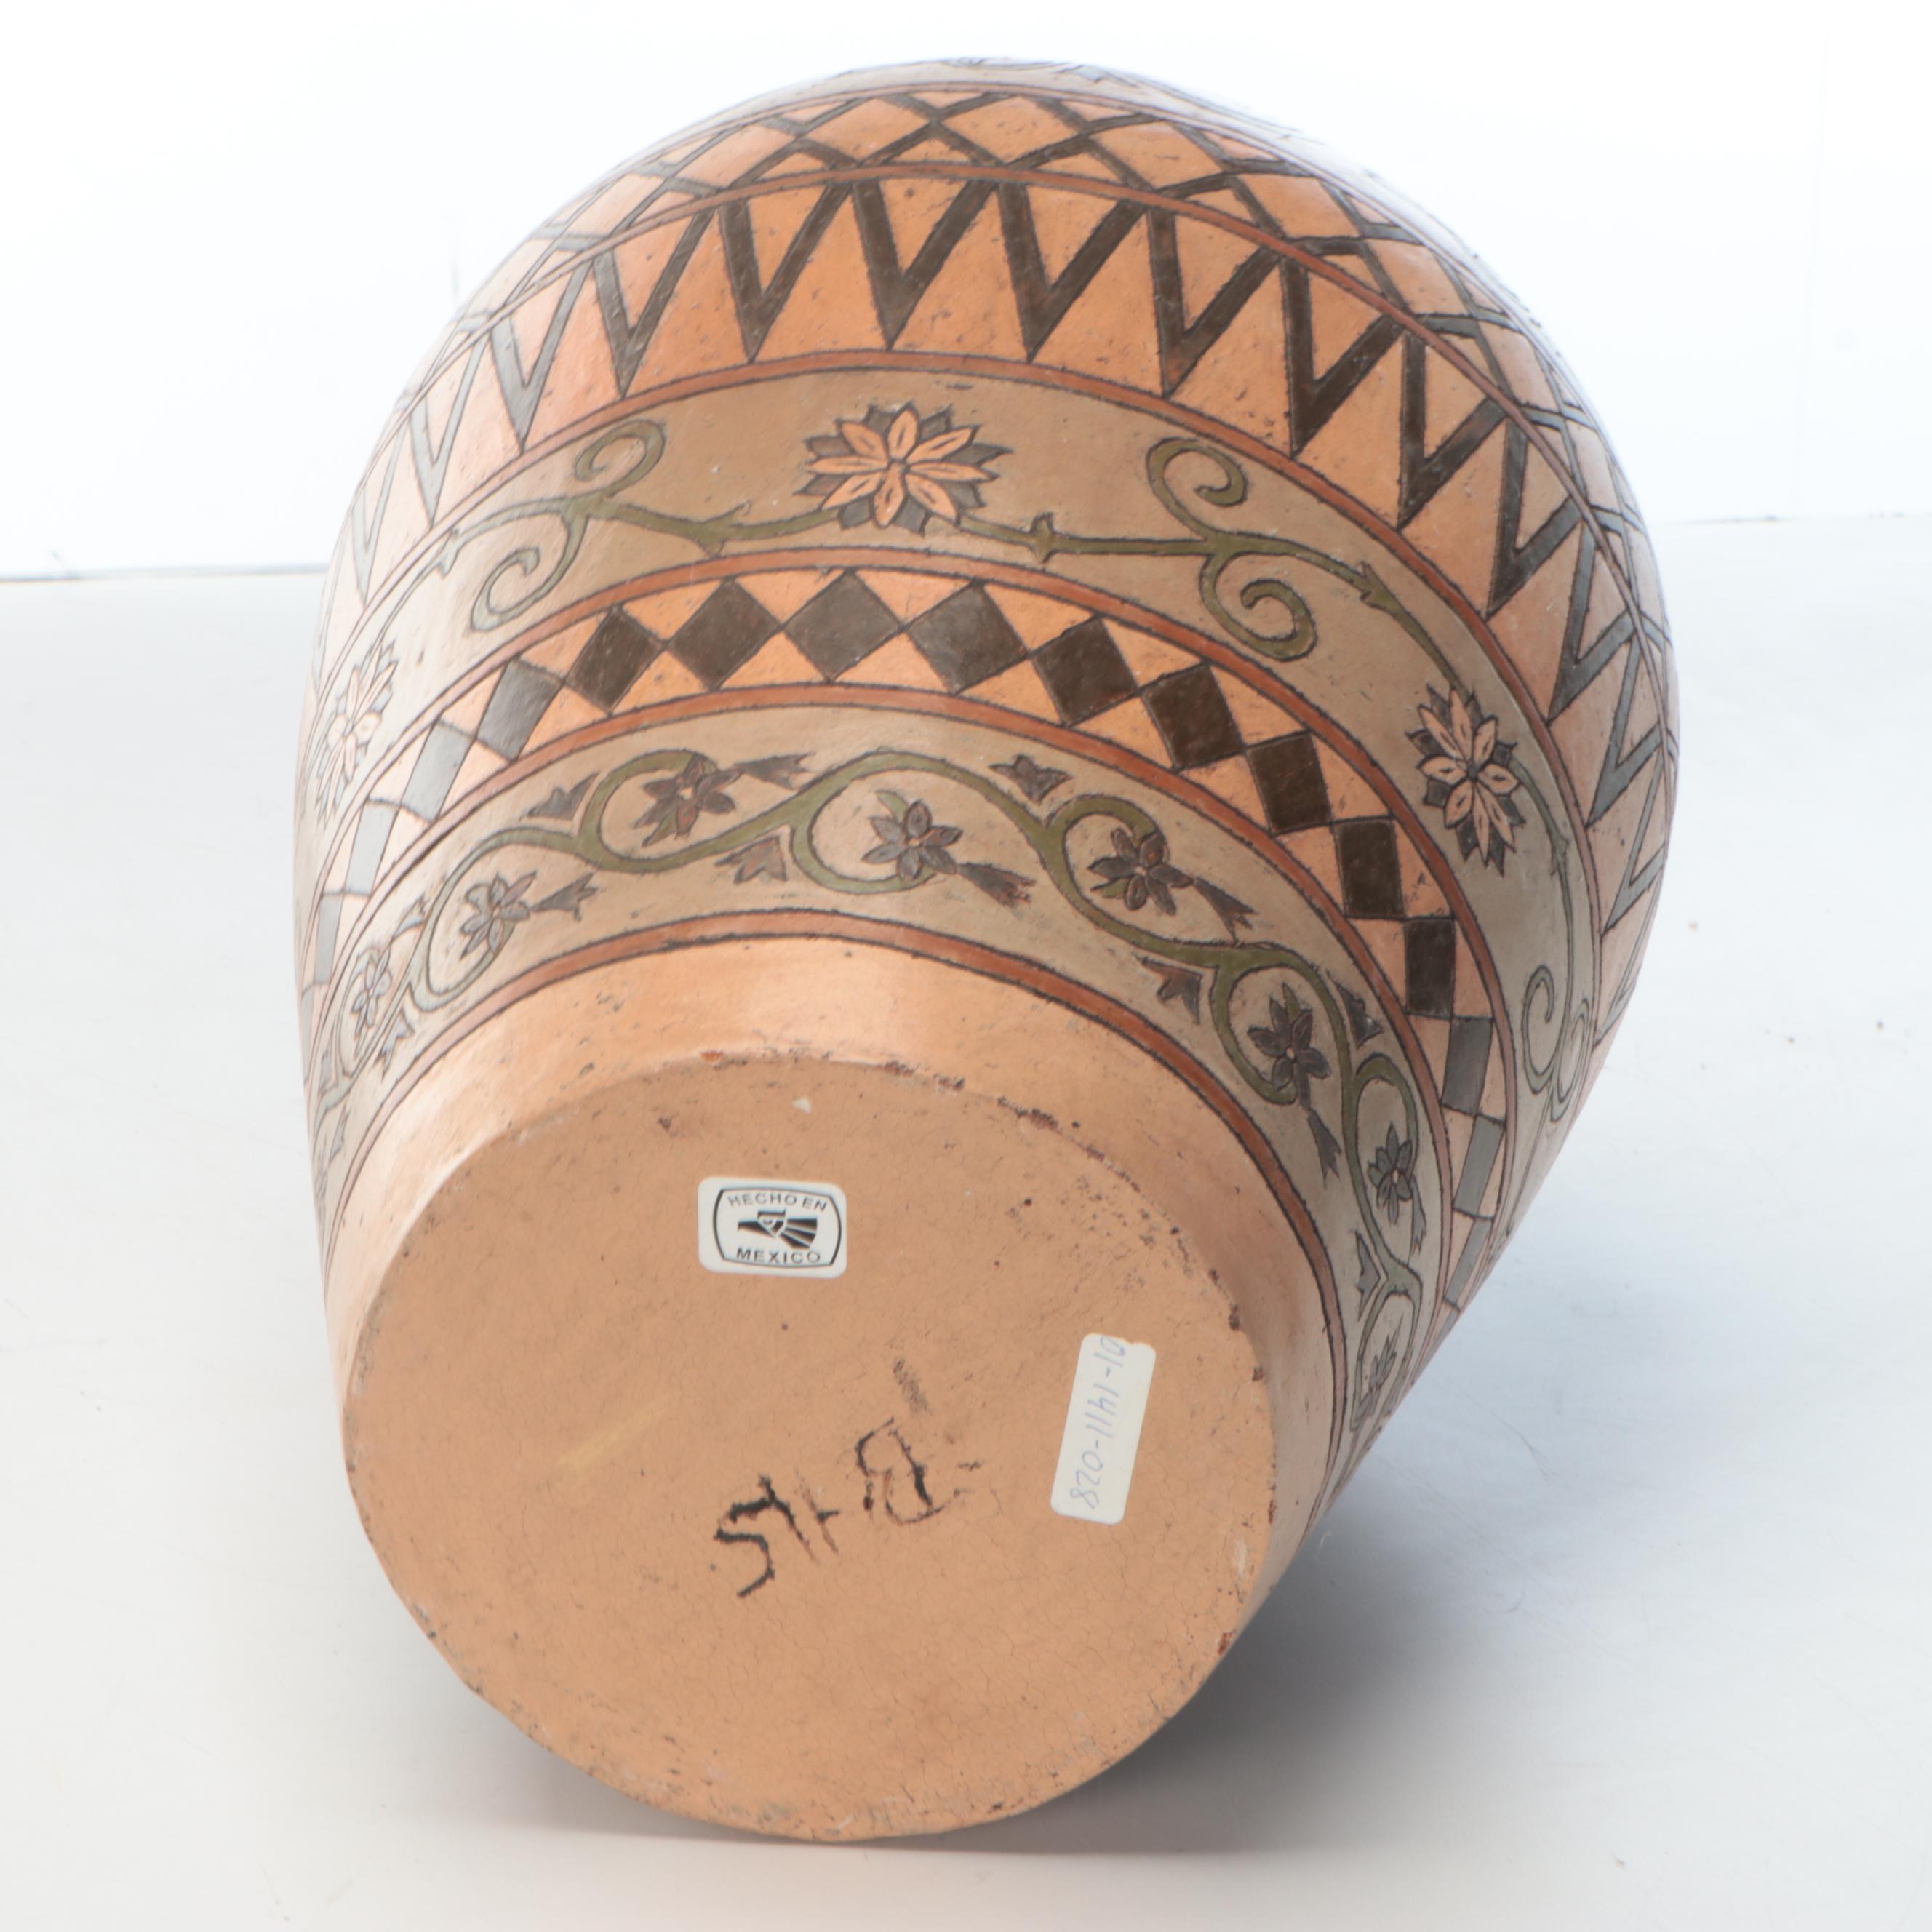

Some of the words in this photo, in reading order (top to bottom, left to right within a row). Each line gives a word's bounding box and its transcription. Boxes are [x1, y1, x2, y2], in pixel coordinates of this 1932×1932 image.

[727, 1191, 798, 1208] HECHO
[801, 1197, 829, 1213] EN
[736, 1246, 821, 1264] MEXICO
